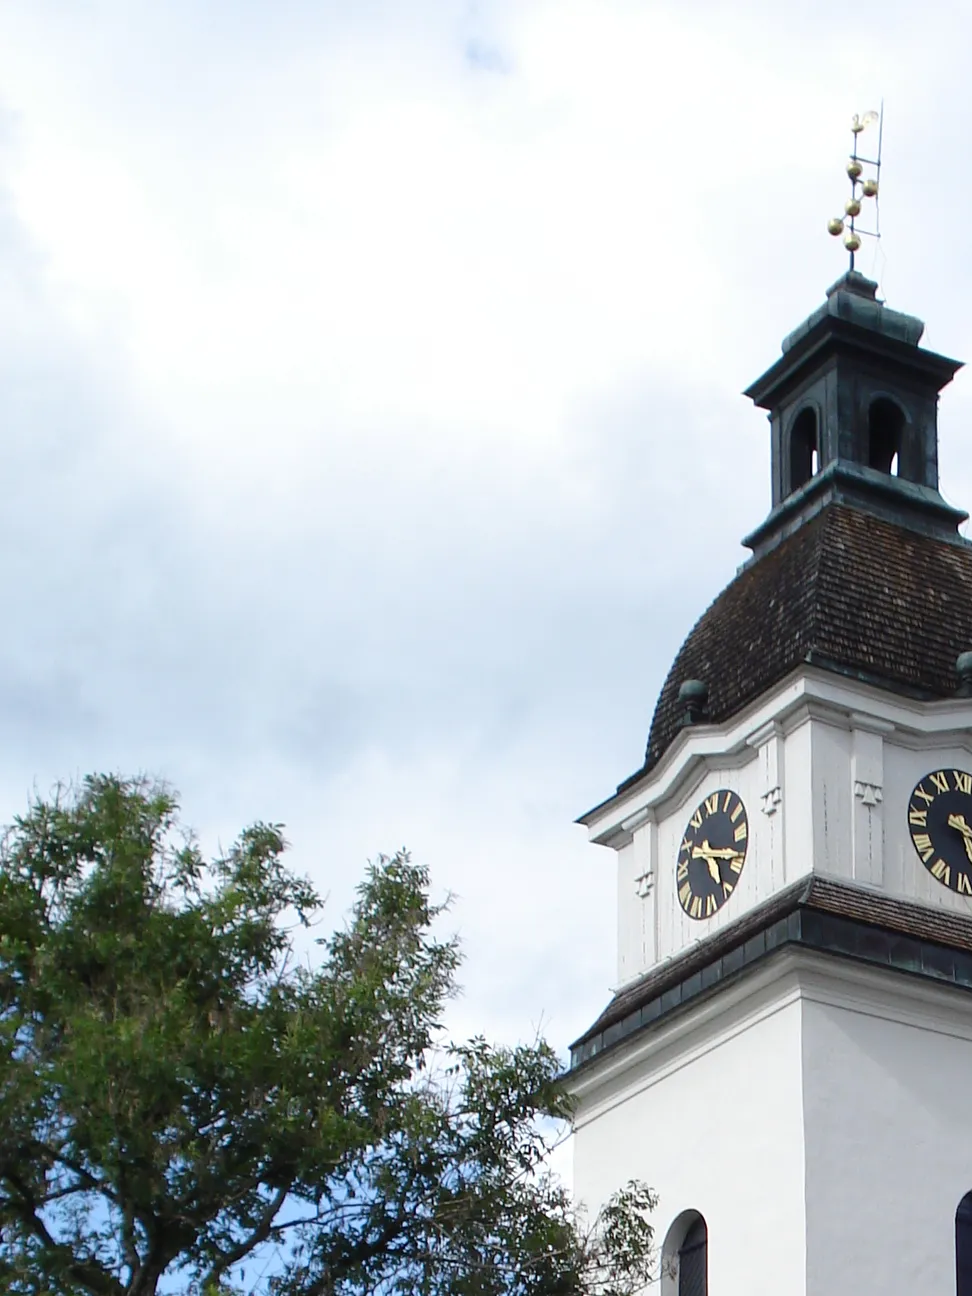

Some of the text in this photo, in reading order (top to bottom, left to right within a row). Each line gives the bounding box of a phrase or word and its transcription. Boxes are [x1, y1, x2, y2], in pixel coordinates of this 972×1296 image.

[929, 771, 949, 794] XI
[953, 771, 972, 794] XII
[705, 793, 719, 818] XII
[723, 792, 731, 812] I
[915, 784, 934, 807] X
[909, 804, 927, 827] IX
[682, 836, 693, 853] X
[723, 882, 733, 899] V
[957, 872, 972, 895] VI
